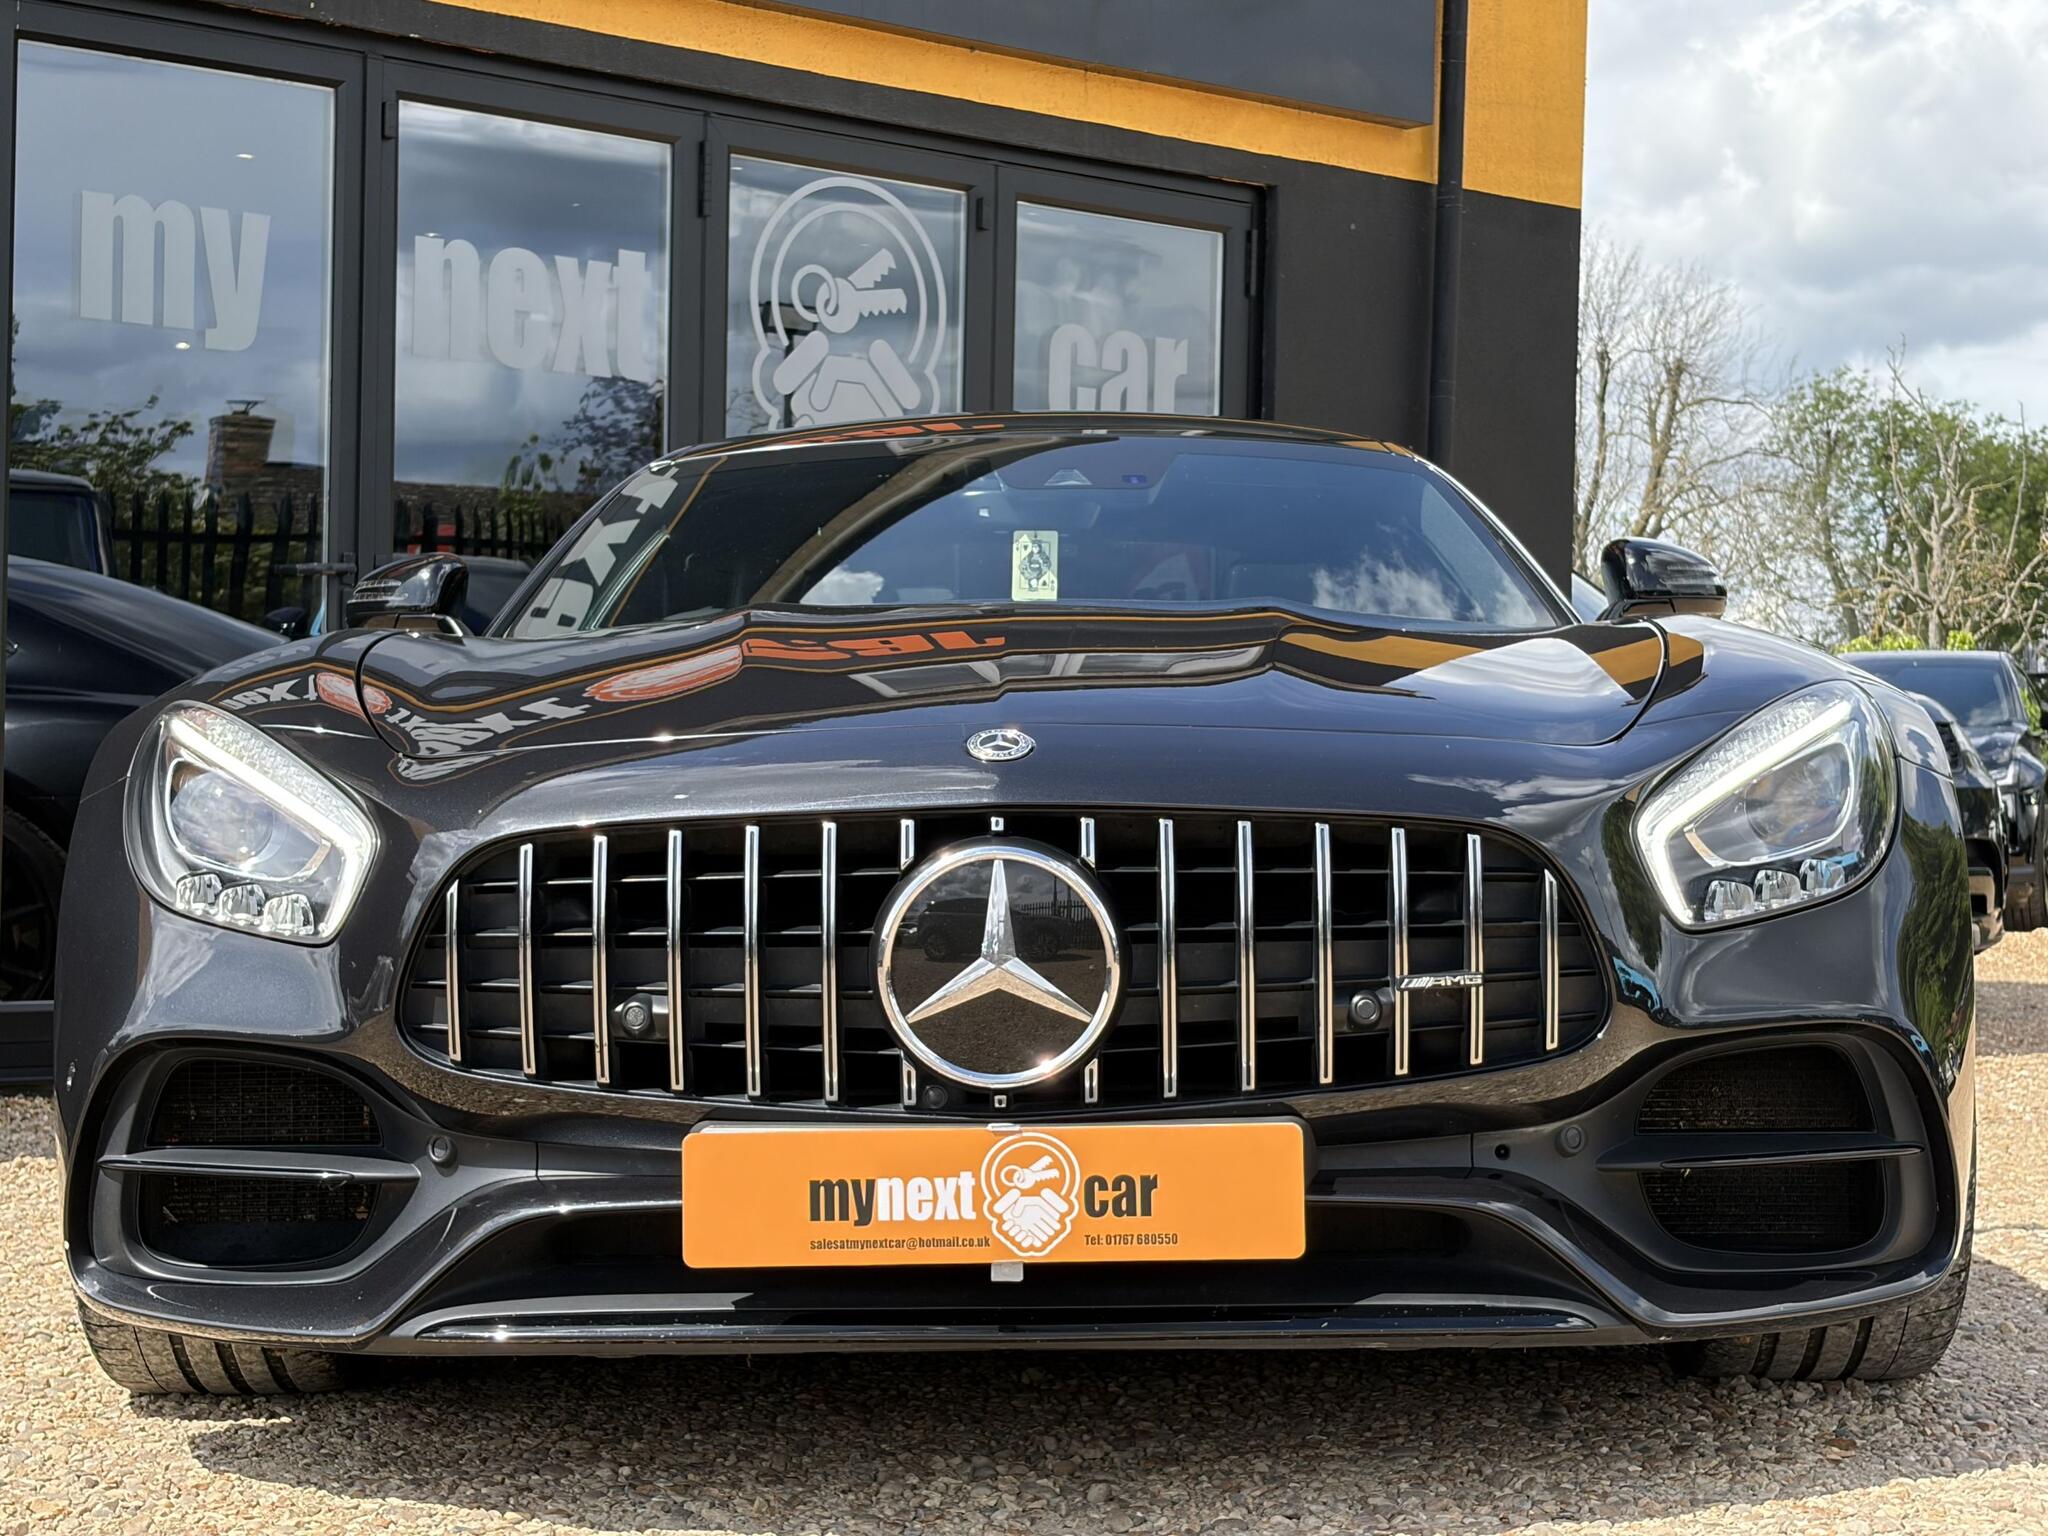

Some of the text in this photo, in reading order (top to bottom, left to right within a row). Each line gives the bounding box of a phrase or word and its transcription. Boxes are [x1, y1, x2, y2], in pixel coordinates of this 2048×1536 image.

[80, 189, 1188, 413] my next car
[1425, 974, 1483, 987] AMG
[1083, 1173, 1158, 1218] car
[810, 1236, 991, 1251] salesatmynextcar@hotmail.co.uk
[1084, 1232, 1179, 1246] Tel: 01767 680550
